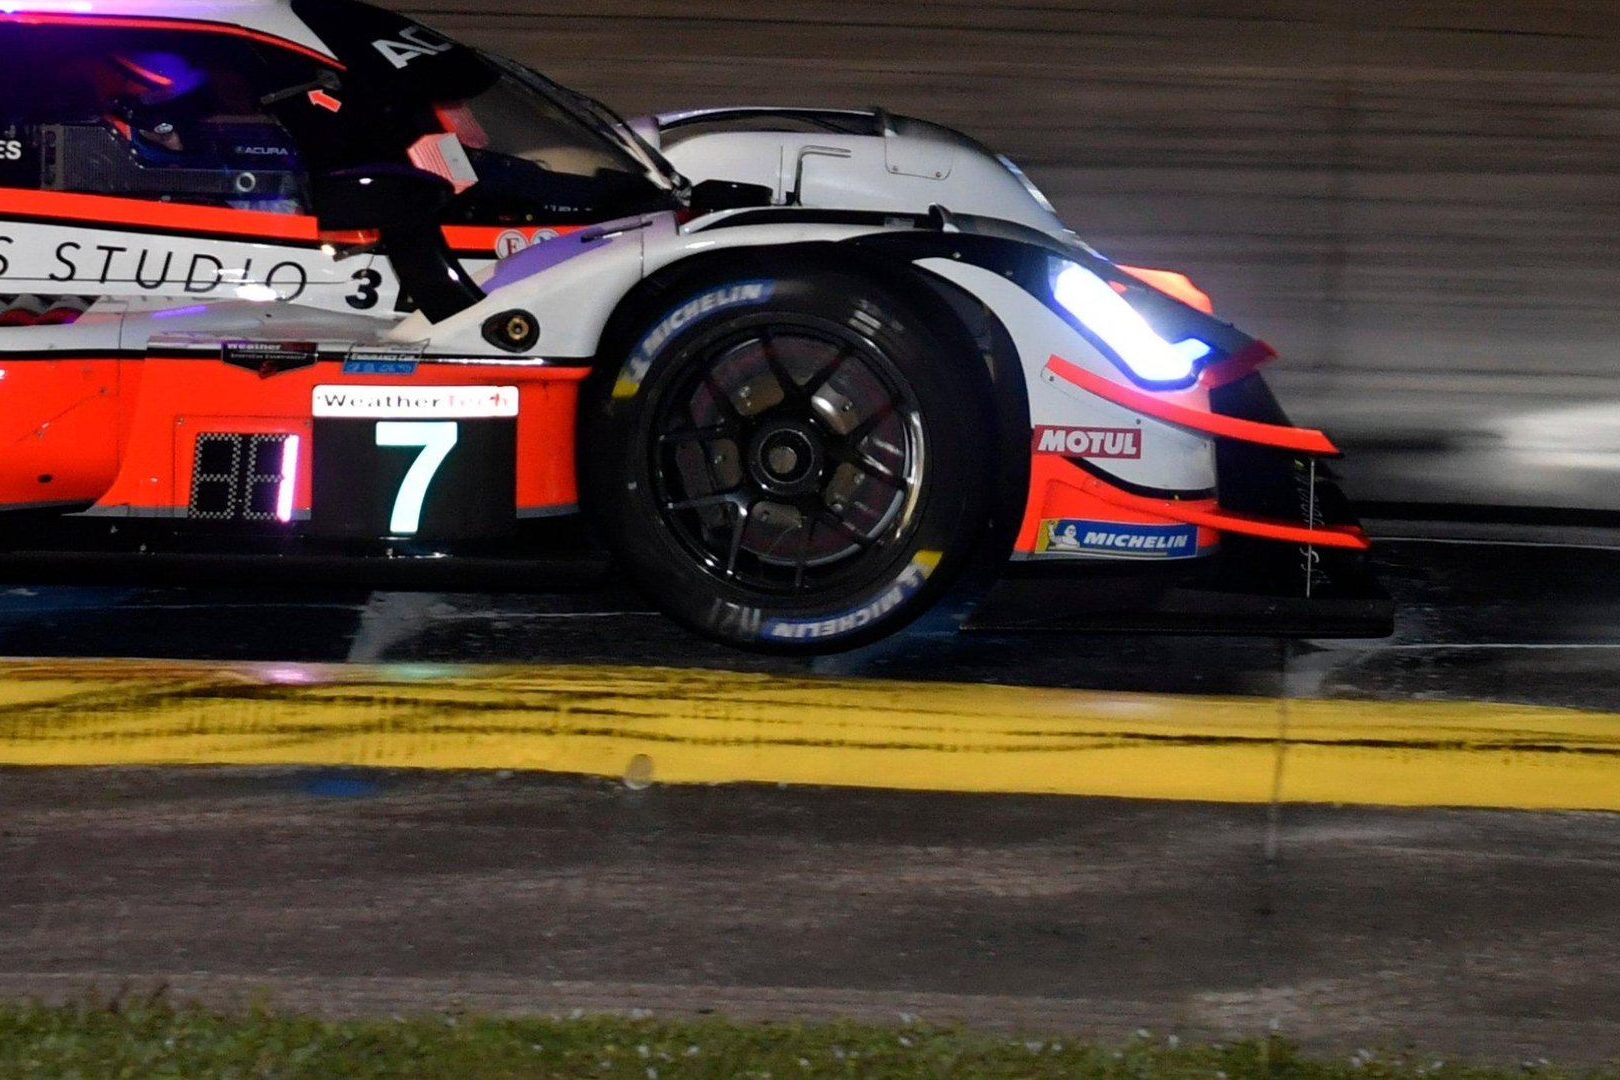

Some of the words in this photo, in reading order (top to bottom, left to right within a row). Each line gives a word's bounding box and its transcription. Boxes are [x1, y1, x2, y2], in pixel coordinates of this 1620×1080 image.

[245, 146, 288, 155] ACURA
[49, 241, 307, 302] STUDIO
[345, 268, 383, 310] 3
[641, 283, 764, 358] MICHELIN
[1037, 429, 1137, 455] MOTUL
[375, 421, 458, 535] 7
[1083, 531, 1189, 549] MICHELIN
[772, 586, 904, 638] MICHELIN
